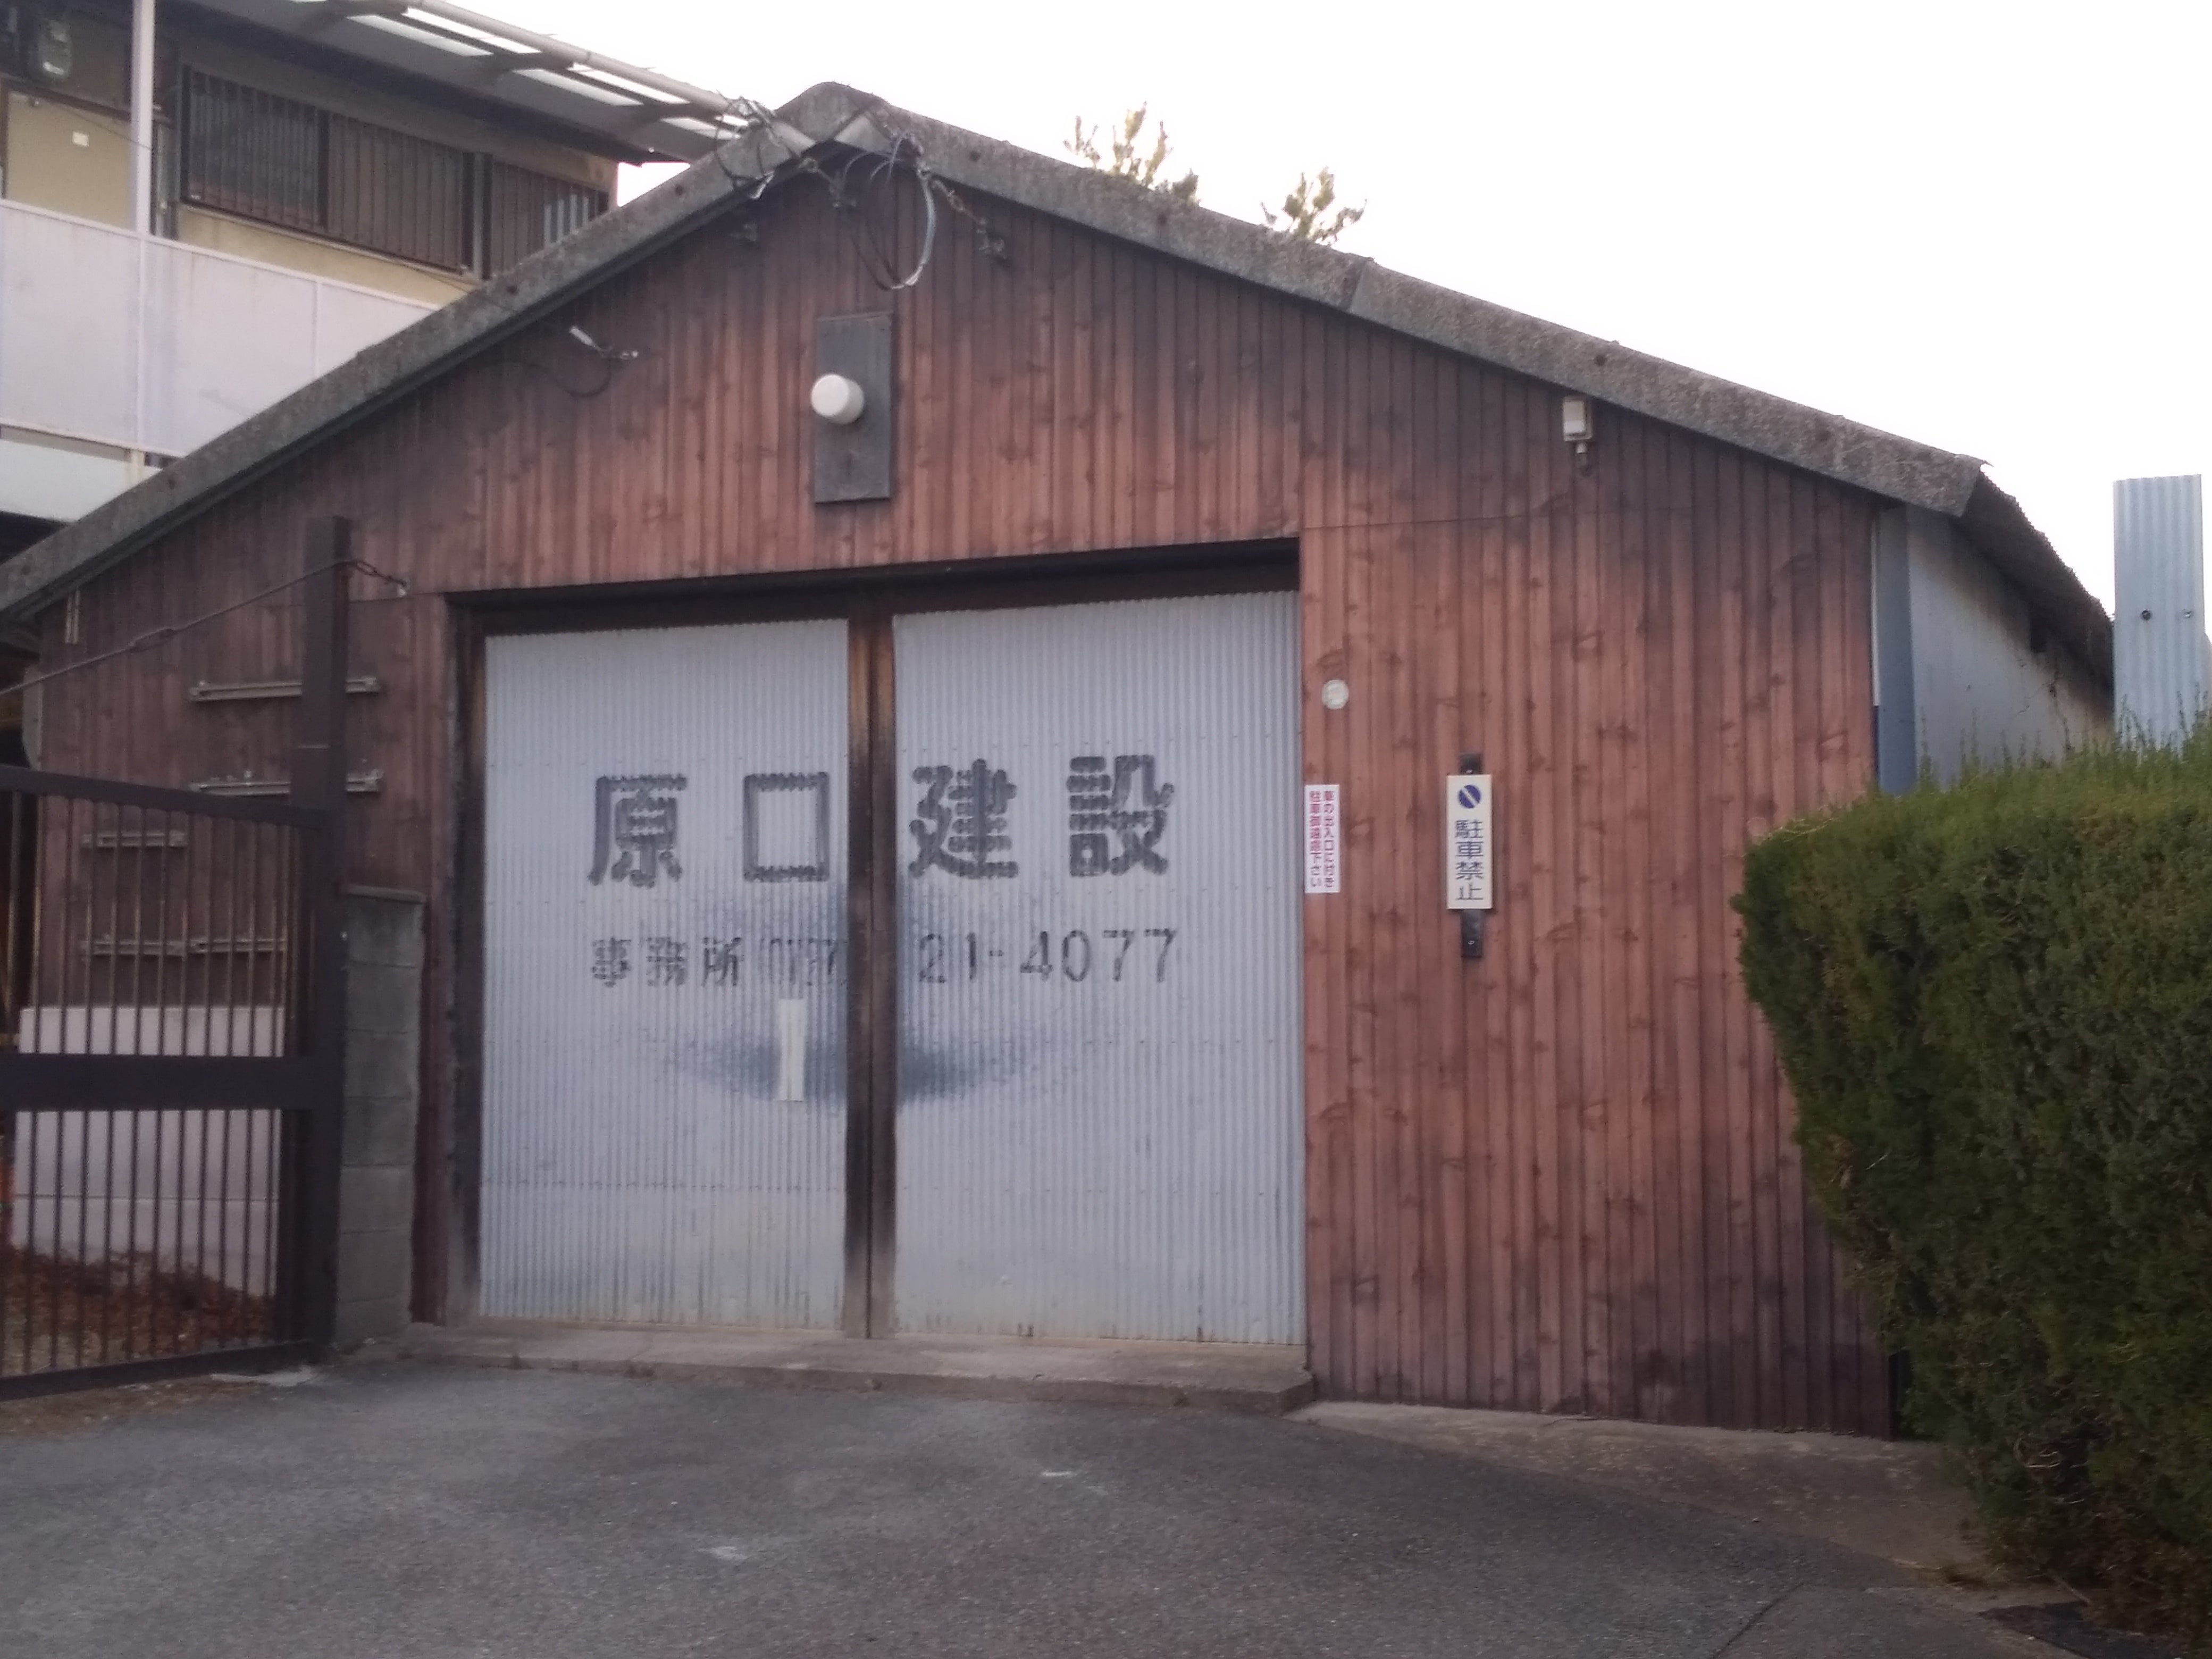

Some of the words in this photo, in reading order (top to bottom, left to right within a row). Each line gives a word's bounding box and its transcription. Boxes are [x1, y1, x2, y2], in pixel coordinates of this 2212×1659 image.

[588, 755, 1174, 887] 原口建設
[1455, 819, 1484, 900] 駐車禁止
[591, 936, 744, 987] 事務所
[918, 928, 1176, 984] 21-4077
